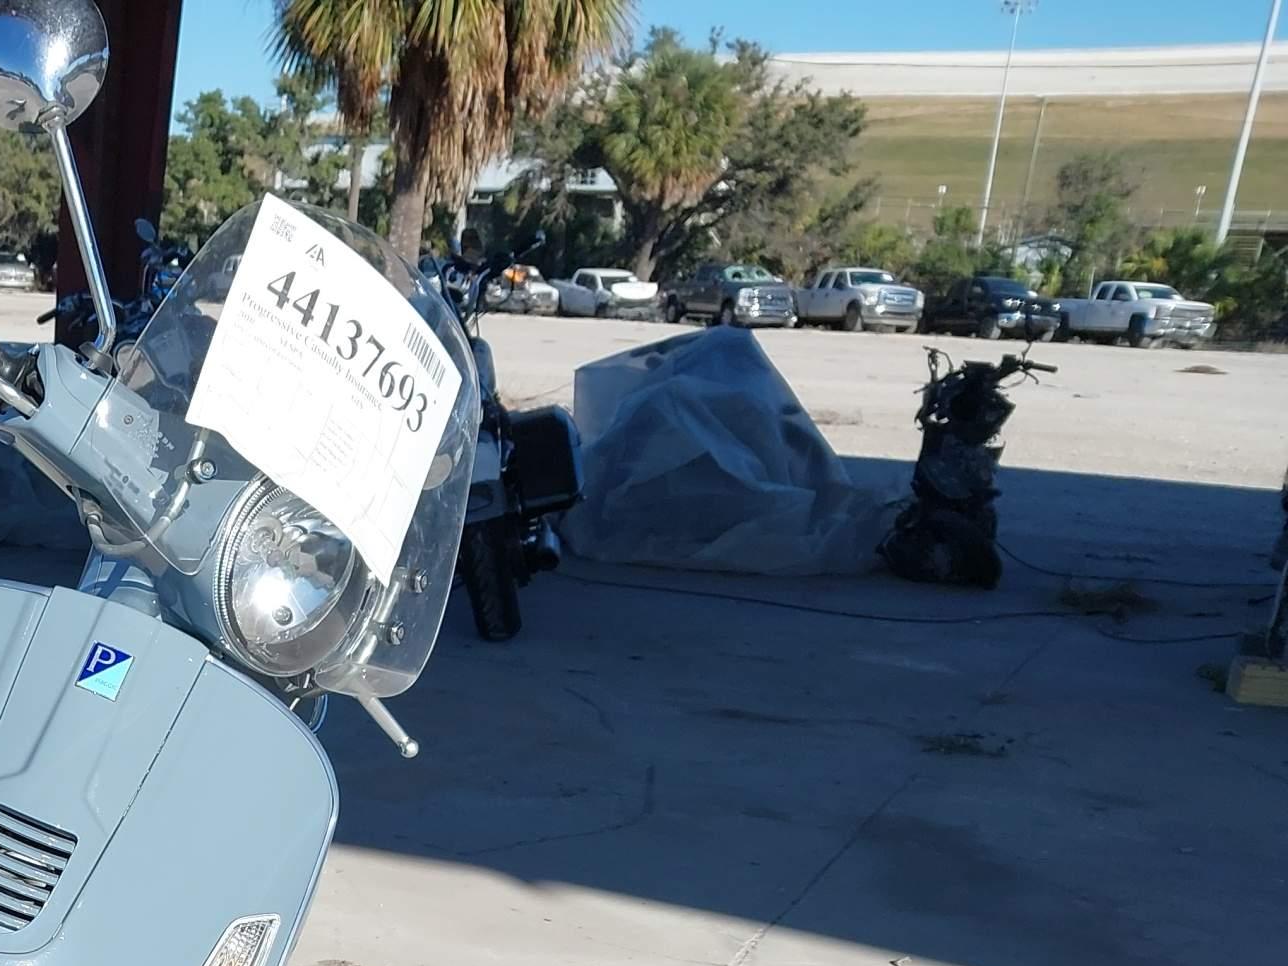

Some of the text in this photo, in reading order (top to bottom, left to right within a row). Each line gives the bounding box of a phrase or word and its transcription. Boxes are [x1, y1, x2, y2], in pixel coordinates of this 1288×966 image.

[241, 291, 303, 341] Progressive
[304, 335, 344, 376] Casualty
[345, 368, 384, 412] Insurance
[267, 271, 428, 433] 44137693
[86, 645, 116, 673] P
